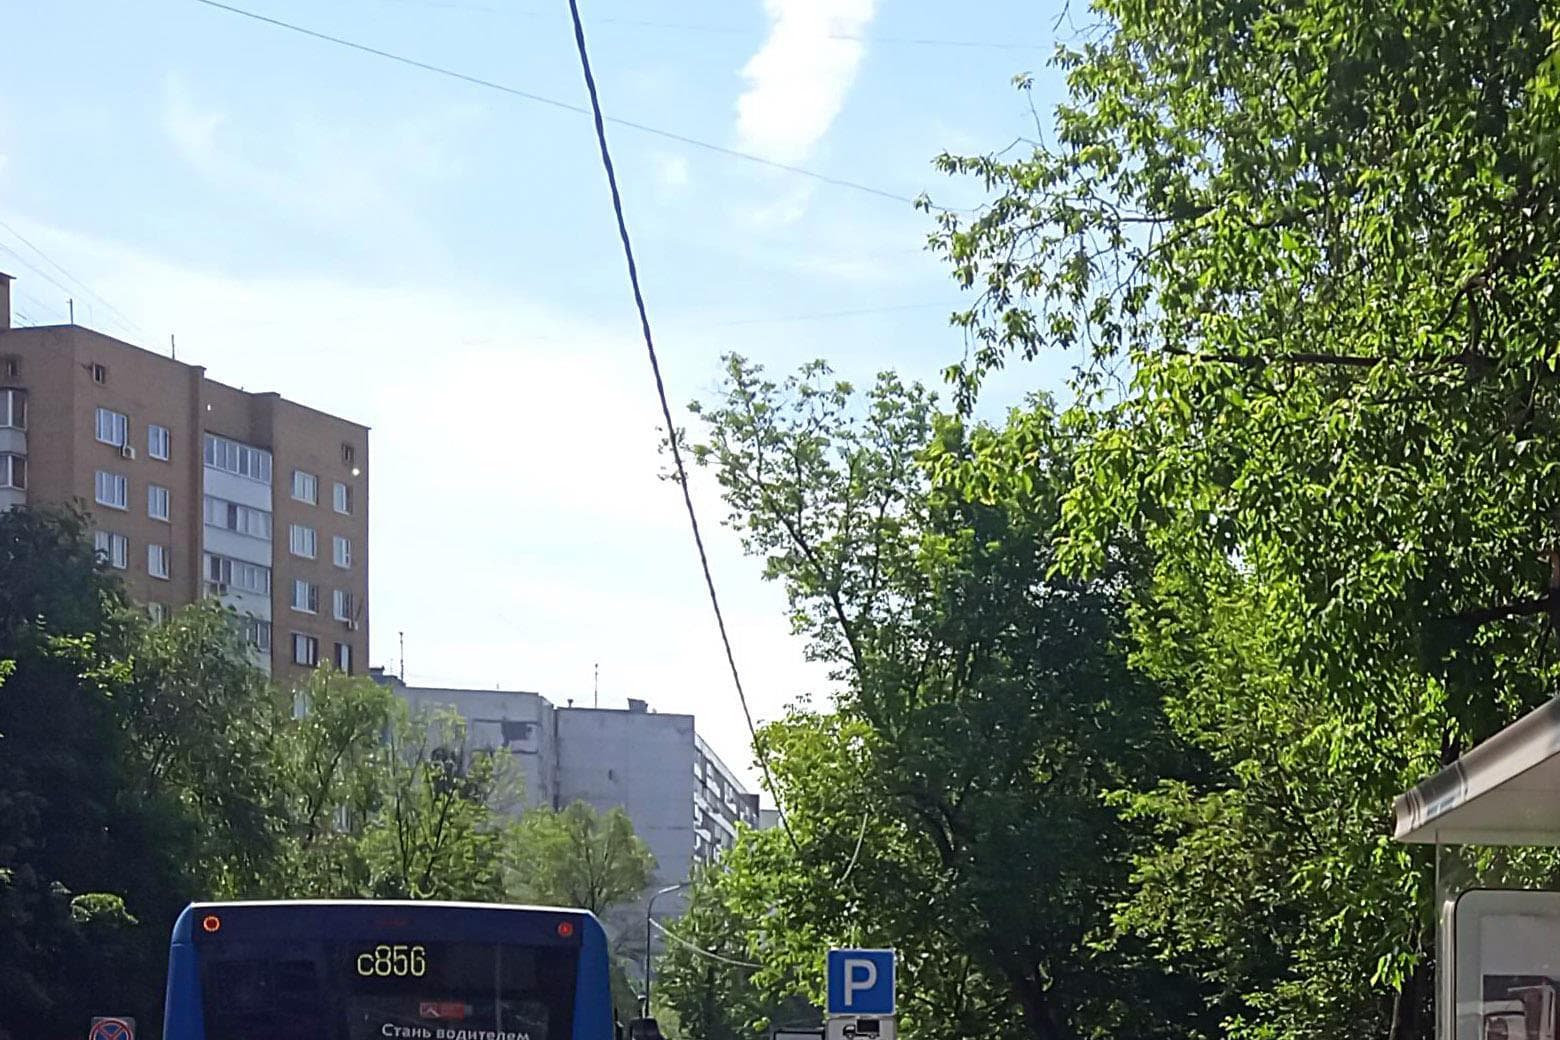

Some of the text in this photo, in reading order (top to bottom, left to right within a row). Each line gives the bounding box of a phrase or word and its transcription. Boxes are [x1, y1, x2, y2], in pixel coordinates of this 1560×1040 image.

[357, 945, 426, 976] с856
[844, 959, 877, 1006] P
[381, 1023, 432, 1039] Стань
